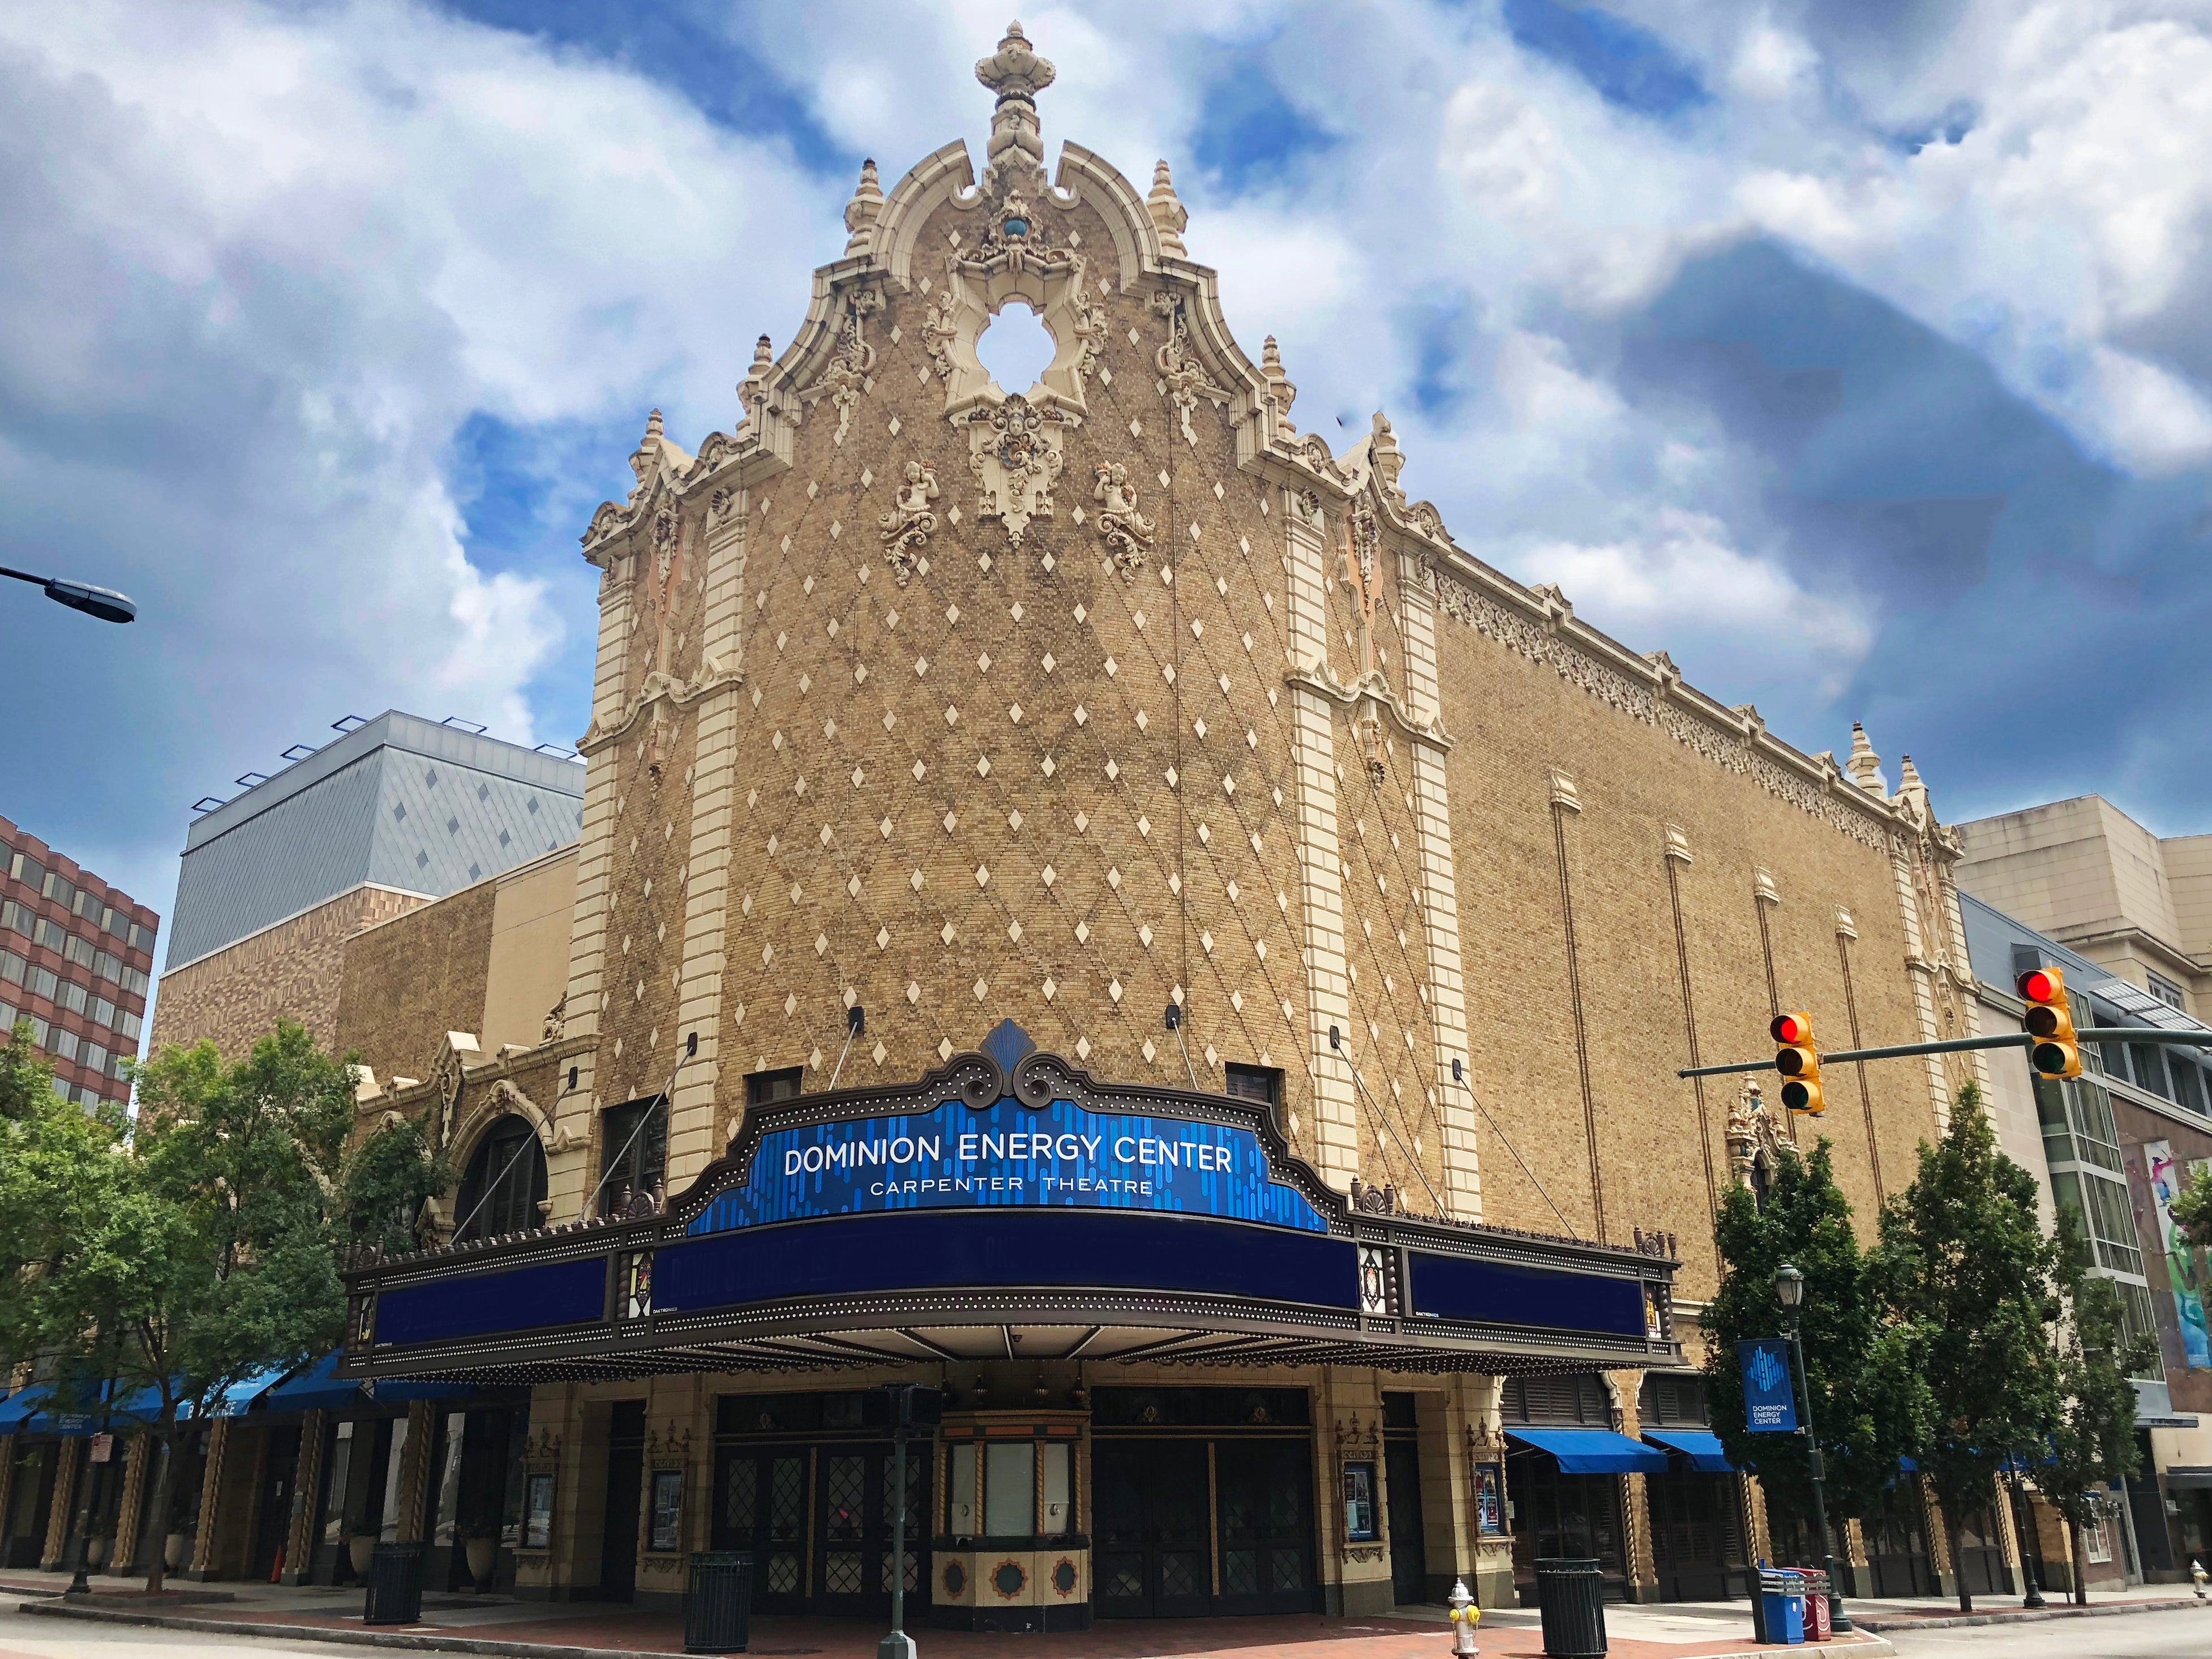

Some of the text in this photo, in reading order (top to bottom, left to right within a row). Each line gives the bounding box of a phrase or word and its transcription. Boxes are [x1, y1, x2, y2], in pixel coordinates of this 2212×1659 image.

[785, 1133, 1232, 1176] DOMINION ENERGY CENTER
[870, 1177, 1152, 1196] CARPENTER THEATRE
